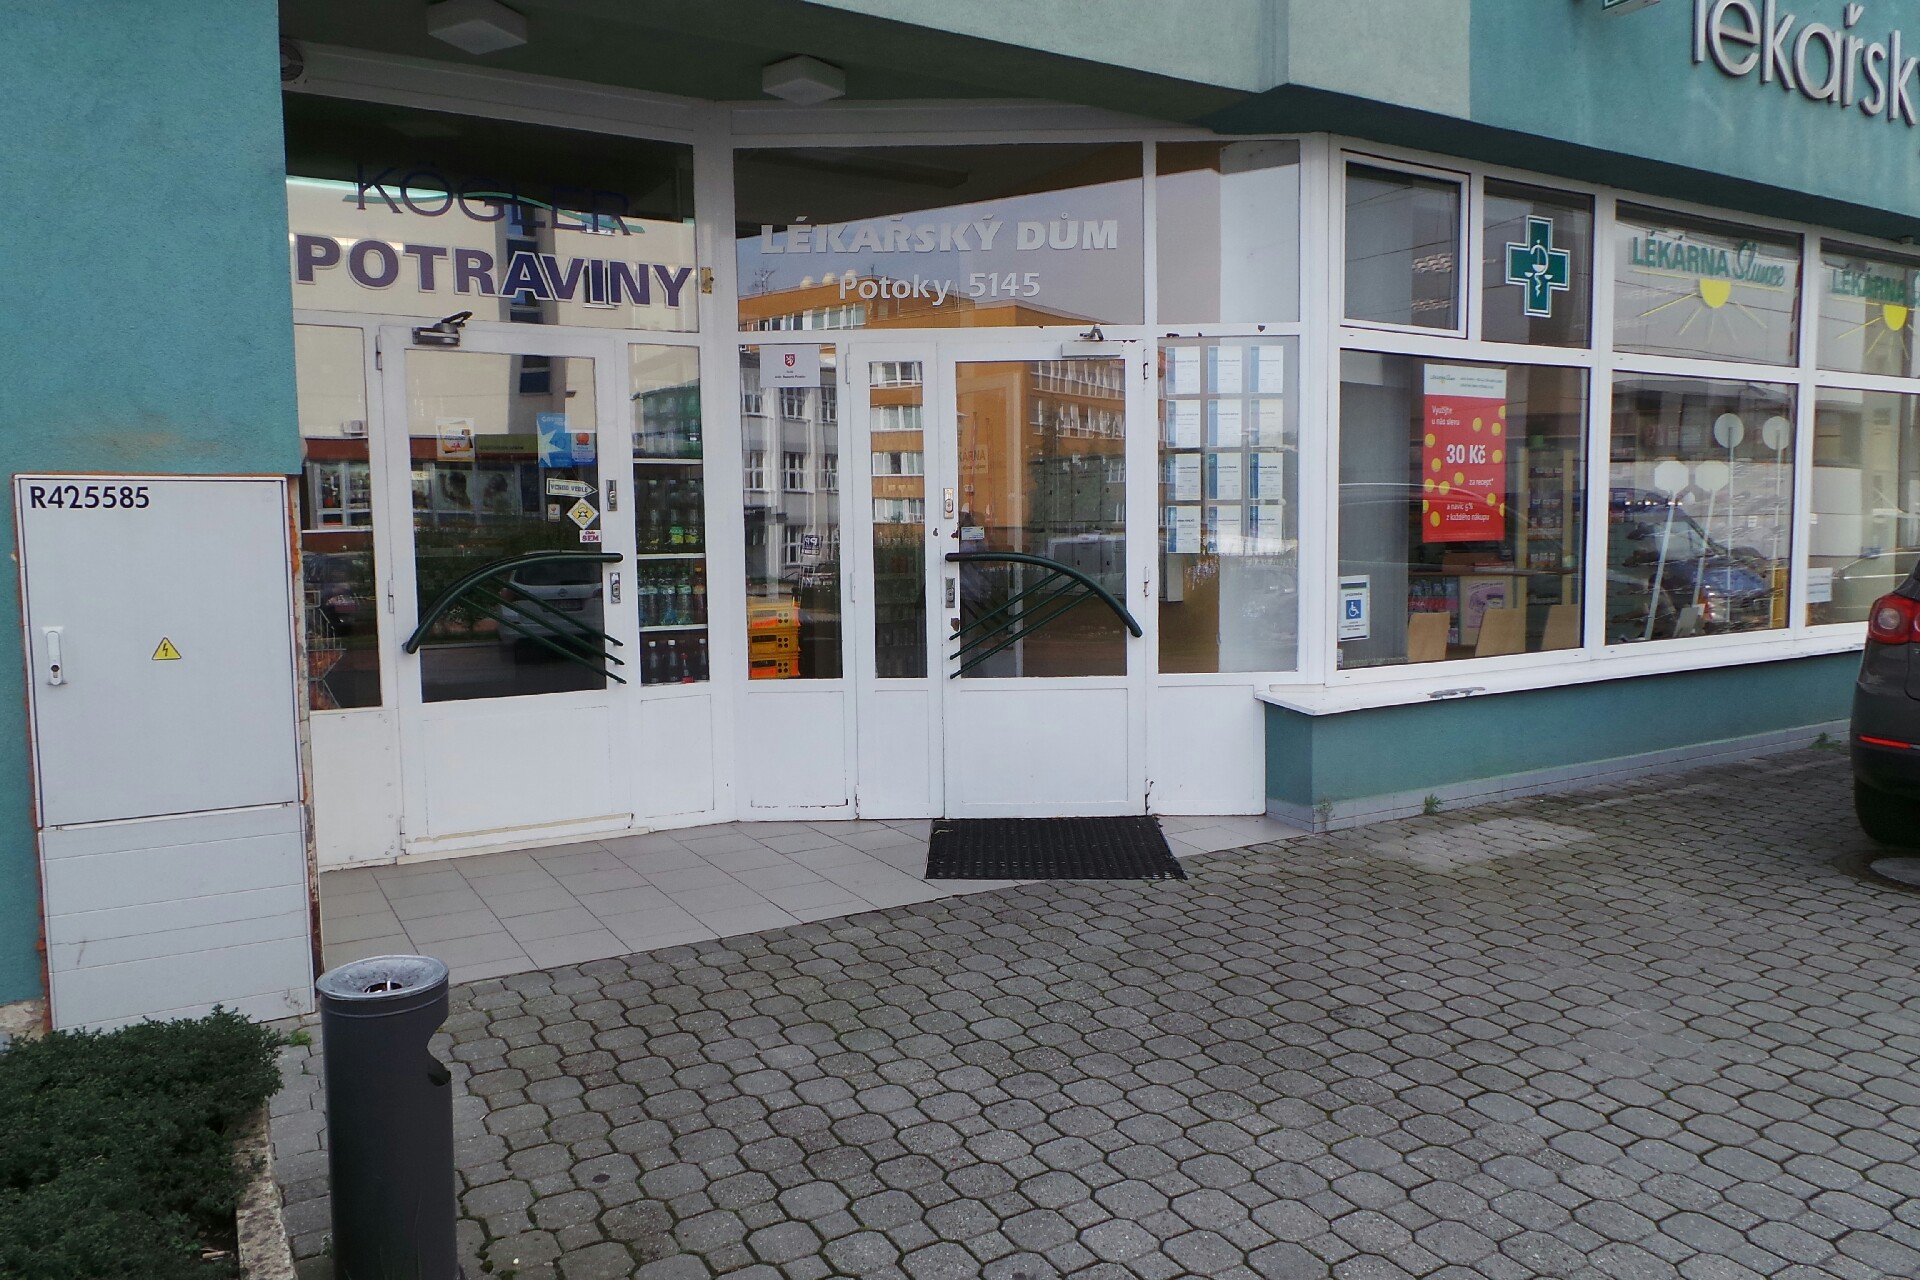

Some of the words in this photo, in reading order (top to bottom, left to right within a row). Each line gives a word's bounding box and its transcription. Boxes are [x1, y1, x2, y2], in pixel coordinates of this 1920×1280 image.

[761, 214, 1003, 254] LÉKAŘSKÝ
[1016, 212, 1119, 251] DŮM
[296, 234, 693, 309] POTRAVINY
[1631, 230, 1729, 277] LÉKÁRNA
[839, 273, 952, 306] Potoky
[968, 272, 1042, 298] 5145
[1446, 444, 1465, 464] 30
[1469, 444, 1486, 464] Kč
[30, 485, 150, 509] R425585
